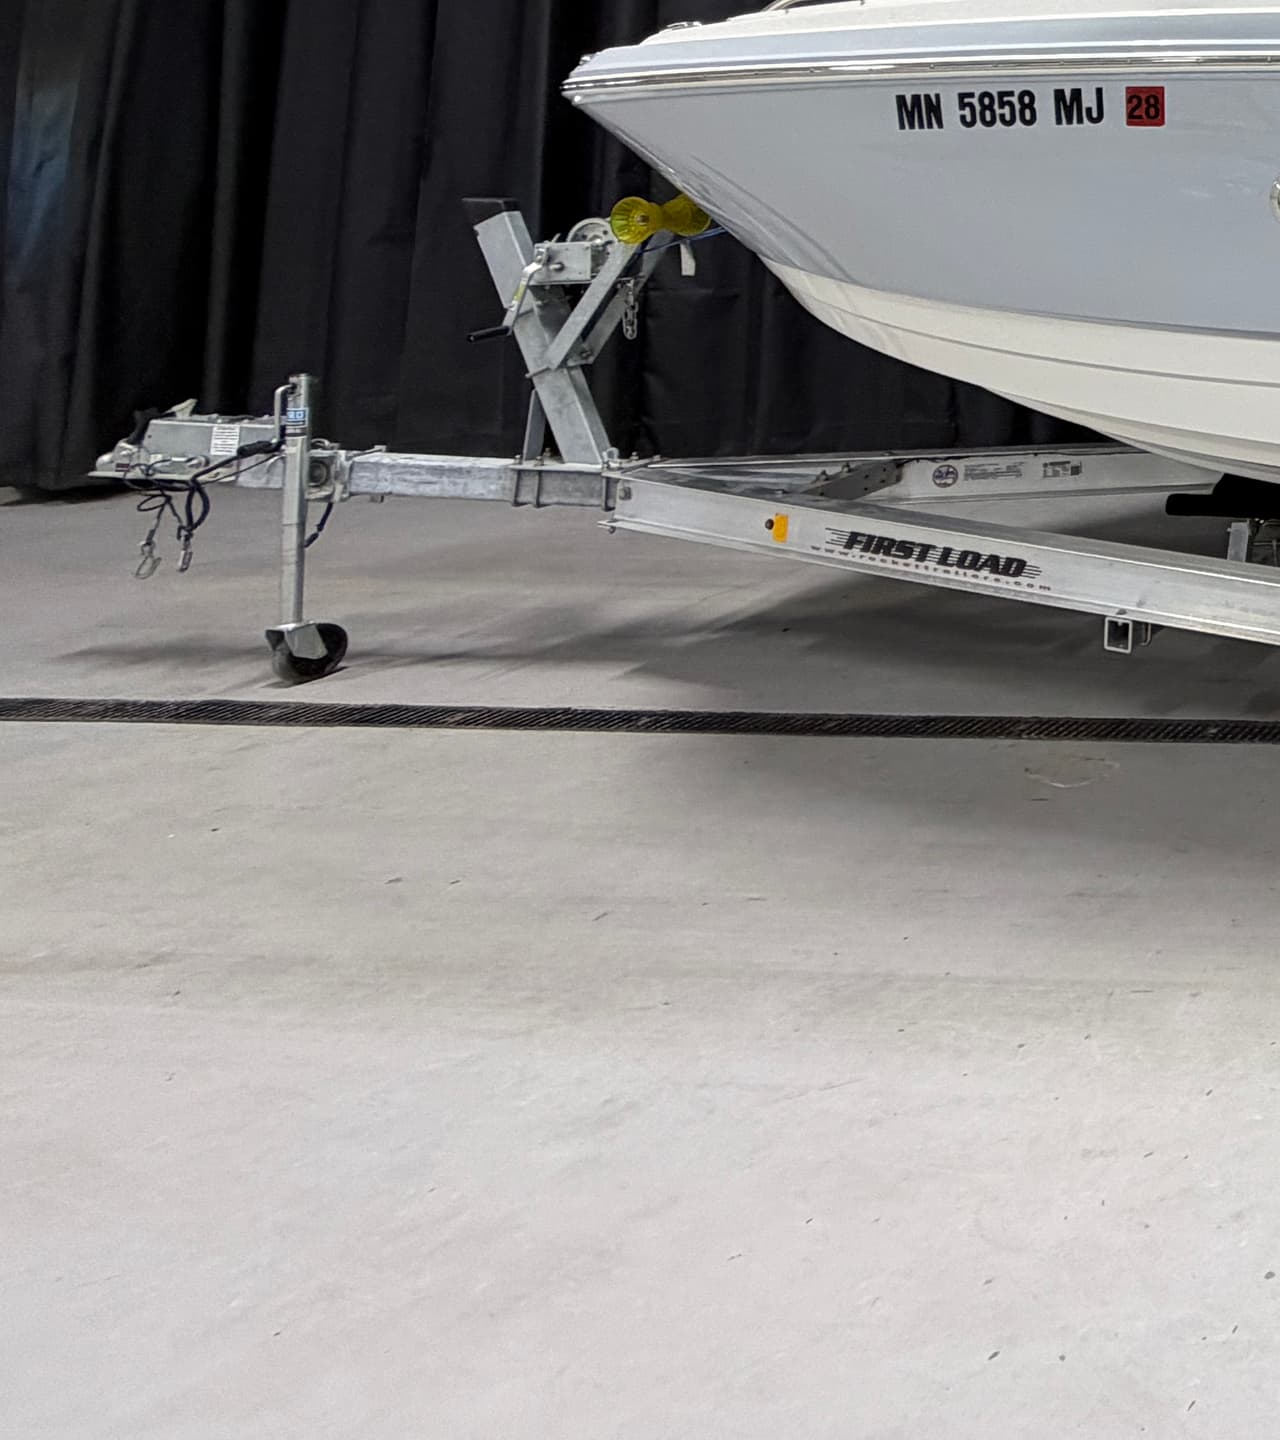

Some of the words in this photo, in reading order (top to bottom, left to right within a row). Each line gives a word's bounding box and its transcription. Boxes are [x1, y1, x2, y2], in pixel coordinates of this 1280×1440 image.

[895, 93, 944, 130] MN
[957, 90, 1037, 127] 5858
[1053, 87, 1104, 125] MJ
[1127, 94, 1160, 120] 28
[843, 531, 937, 562] FIRST
[936, 546, 1027, 578] LOAD
